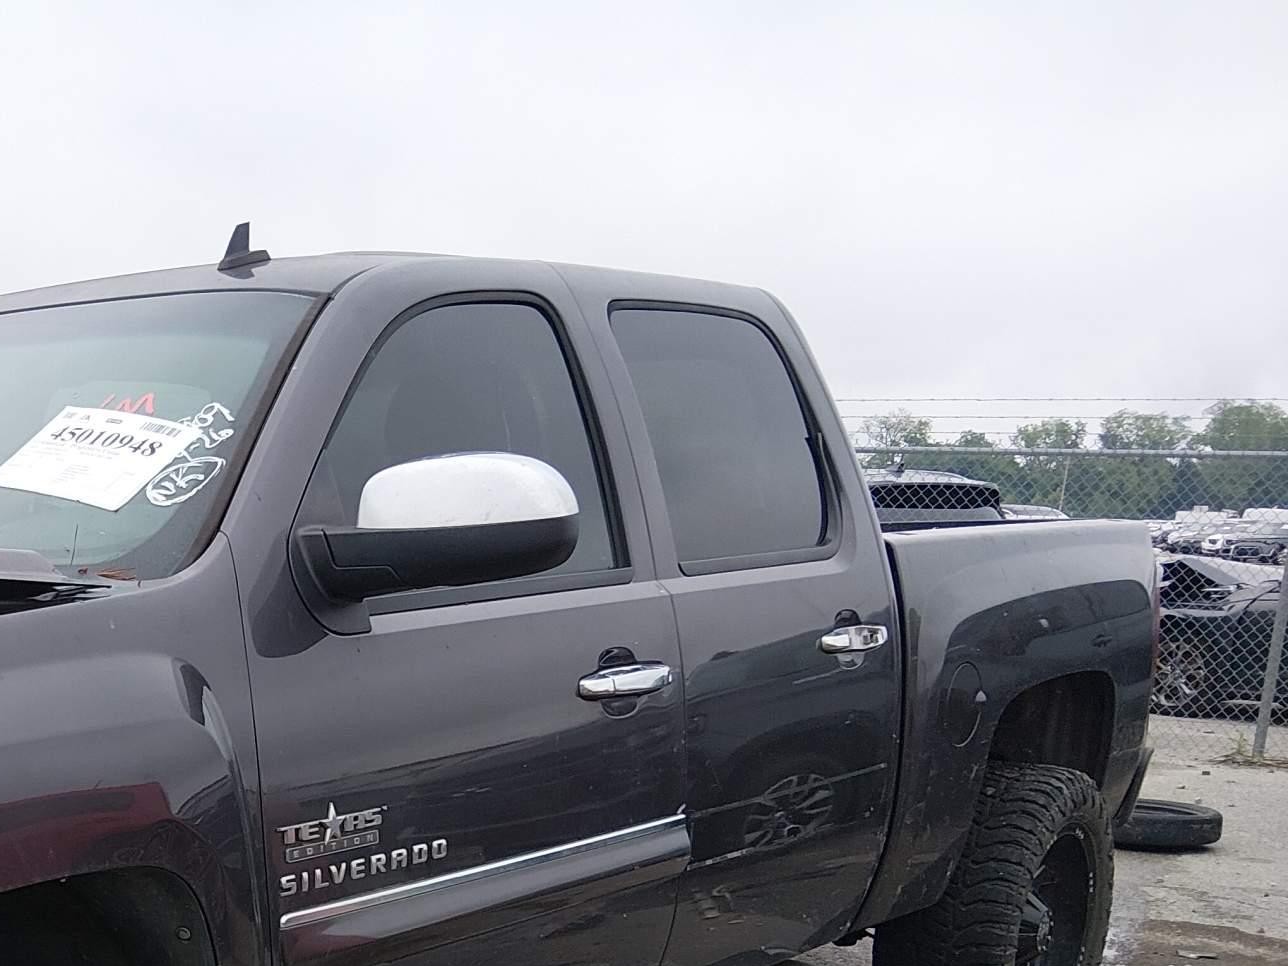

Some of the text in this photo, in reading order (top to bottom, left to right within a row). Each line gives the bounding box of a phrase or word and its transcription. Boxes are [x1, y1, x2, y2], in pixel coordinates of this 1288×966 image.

[50, 426, 163, 457] 45010948
[276, 802, 388, 845] TEXAS
[292, 834, 375, 859] EDITION
[279, 838, 448, 897] SILVERADO
